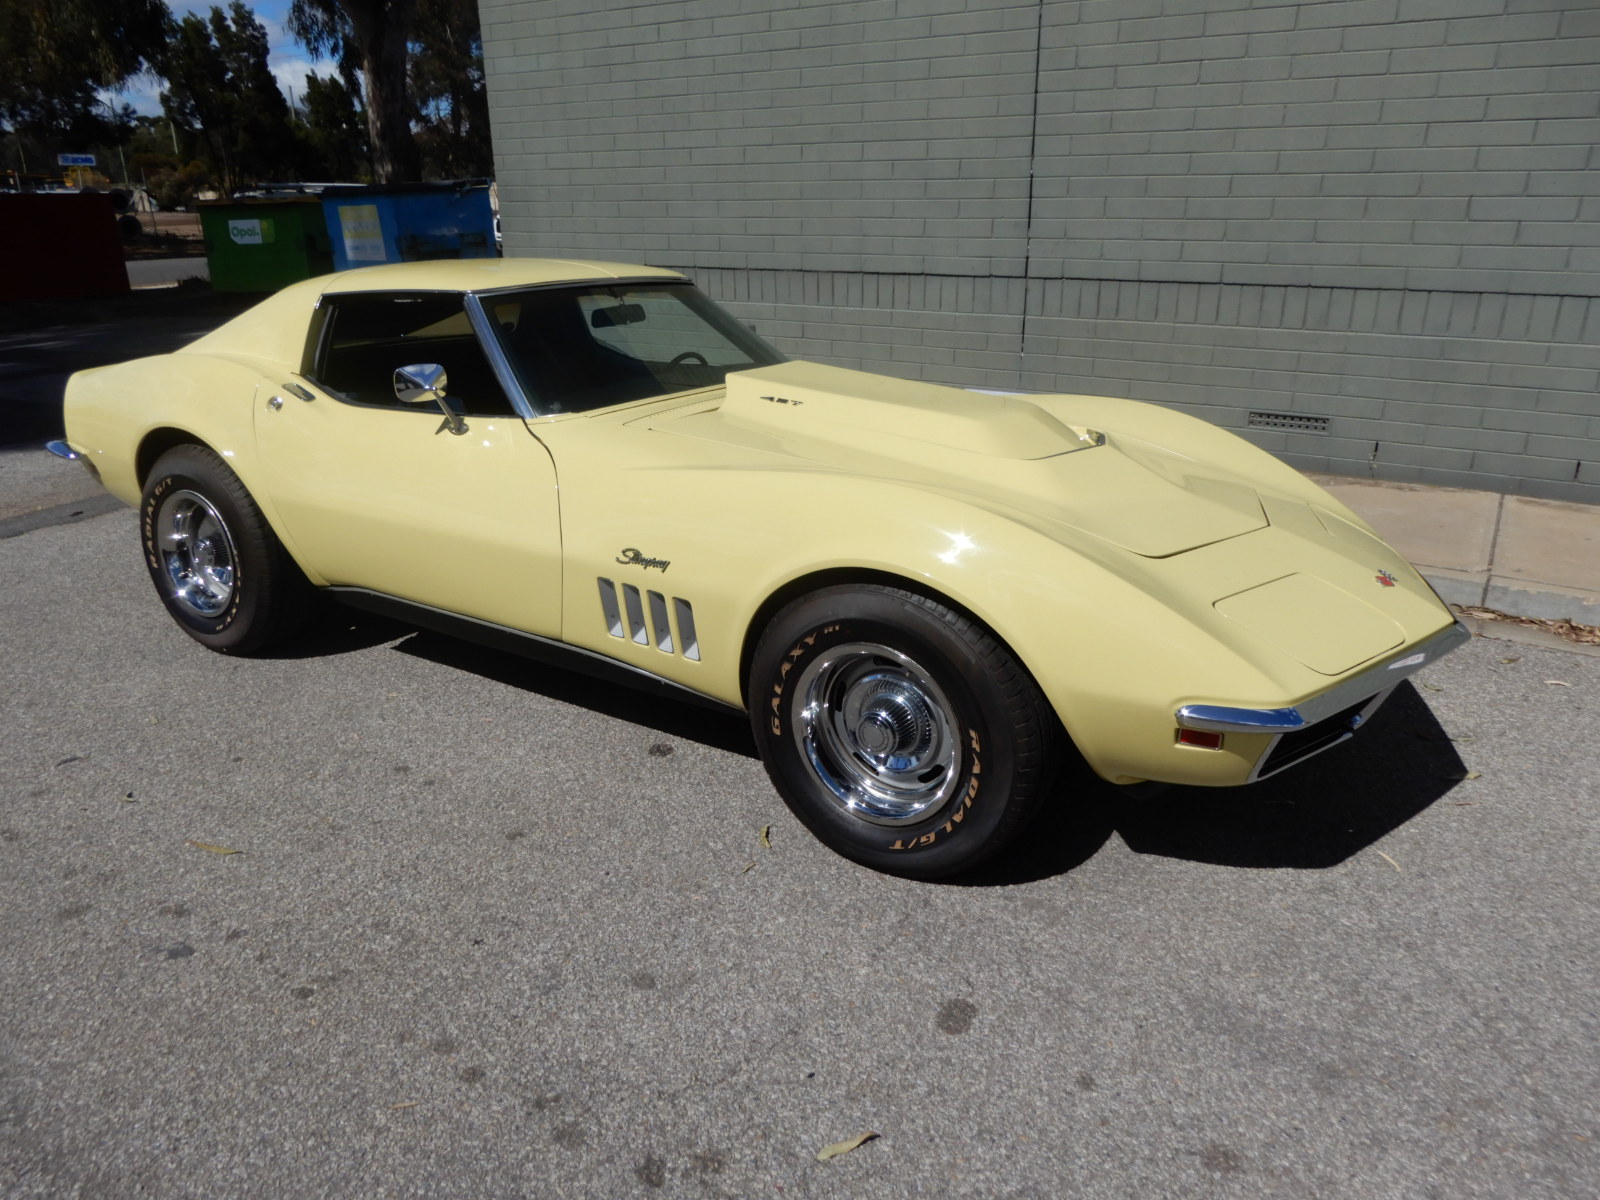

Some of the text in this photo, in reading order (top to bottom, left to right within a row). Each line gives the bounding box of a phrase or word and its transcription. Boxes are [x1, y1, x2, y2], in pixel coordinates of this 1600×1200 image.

[145, 498, 158, 569] RADIAL
[615, 548, 671, 574] Stingray
[771, 631, 818, 736] GALAXY
[888, 728, 981, 850] RADIAL G/T
